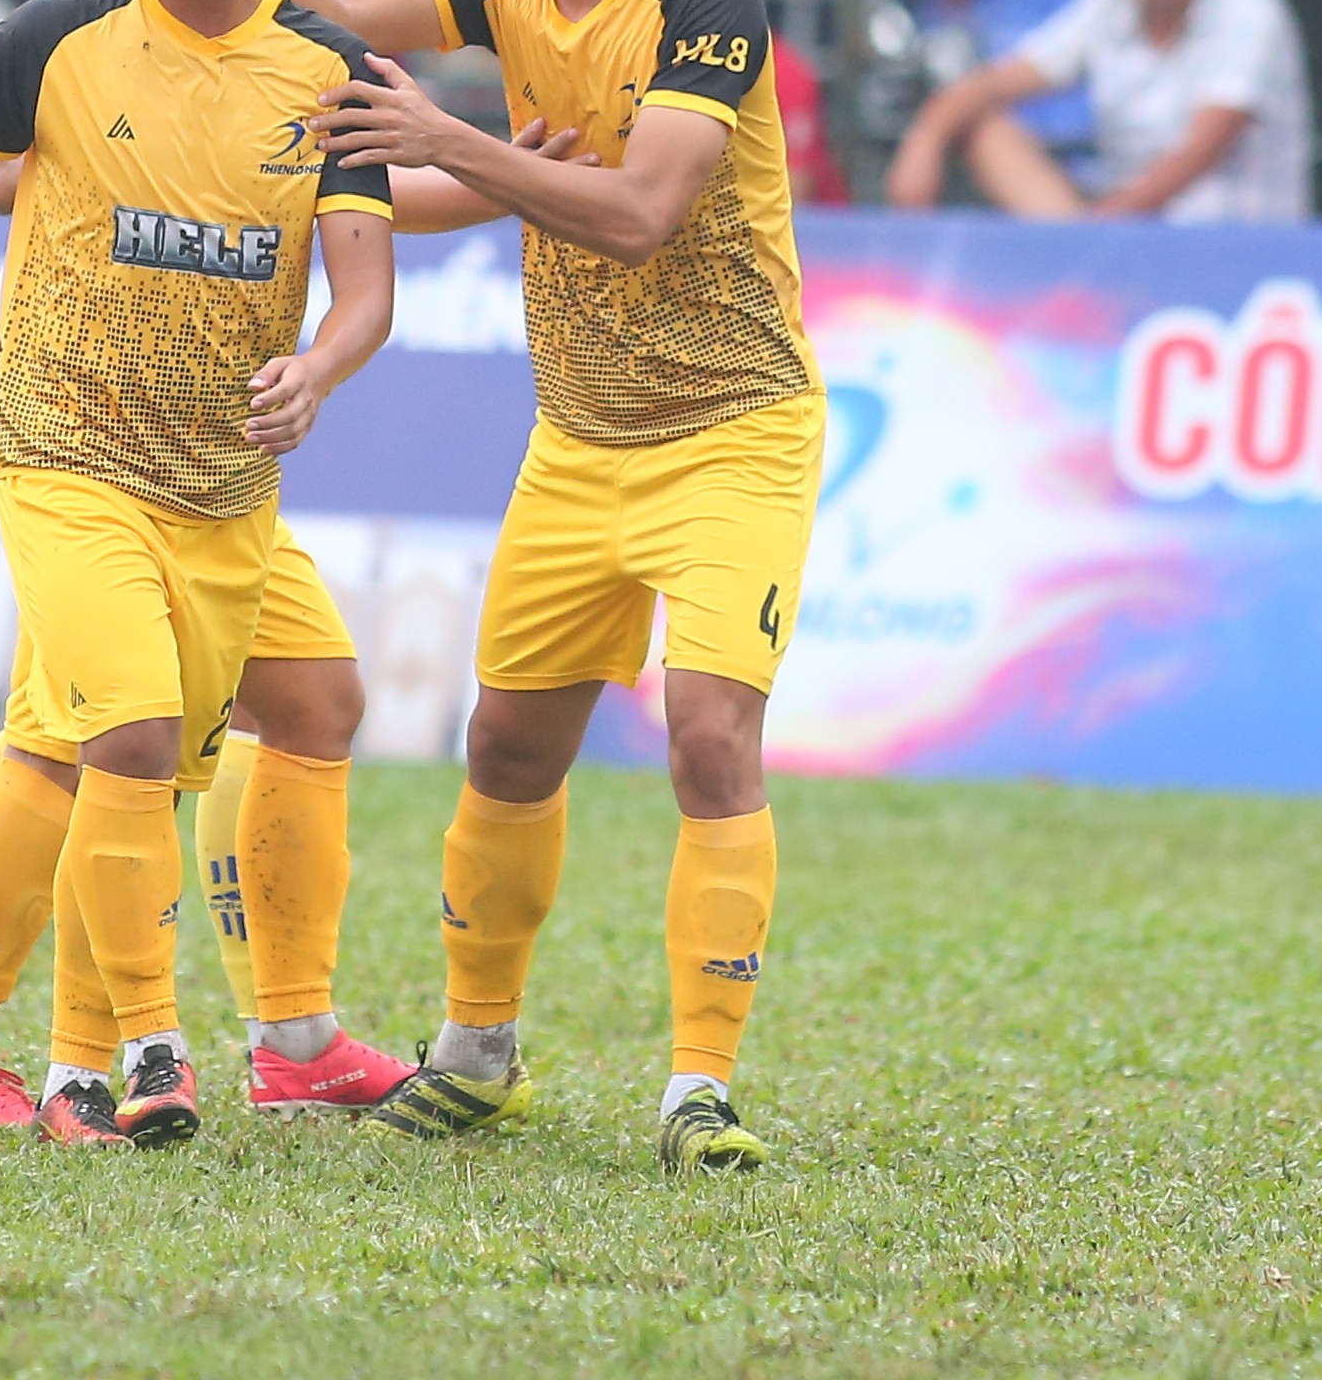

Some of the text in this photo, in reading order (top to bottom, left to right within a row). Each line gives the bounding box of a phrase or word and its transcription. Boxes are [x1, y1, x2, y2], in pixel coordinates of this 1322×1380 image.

[671, 32, 750, 74] HL8
[113, 206, 283, 280] HELE
[758, 582, 780, 651] 4
[199, 697, 234, 758] 2
[701, 966, 758, 981] adida
[310, 1068, 367, 1092] NEMESIS
